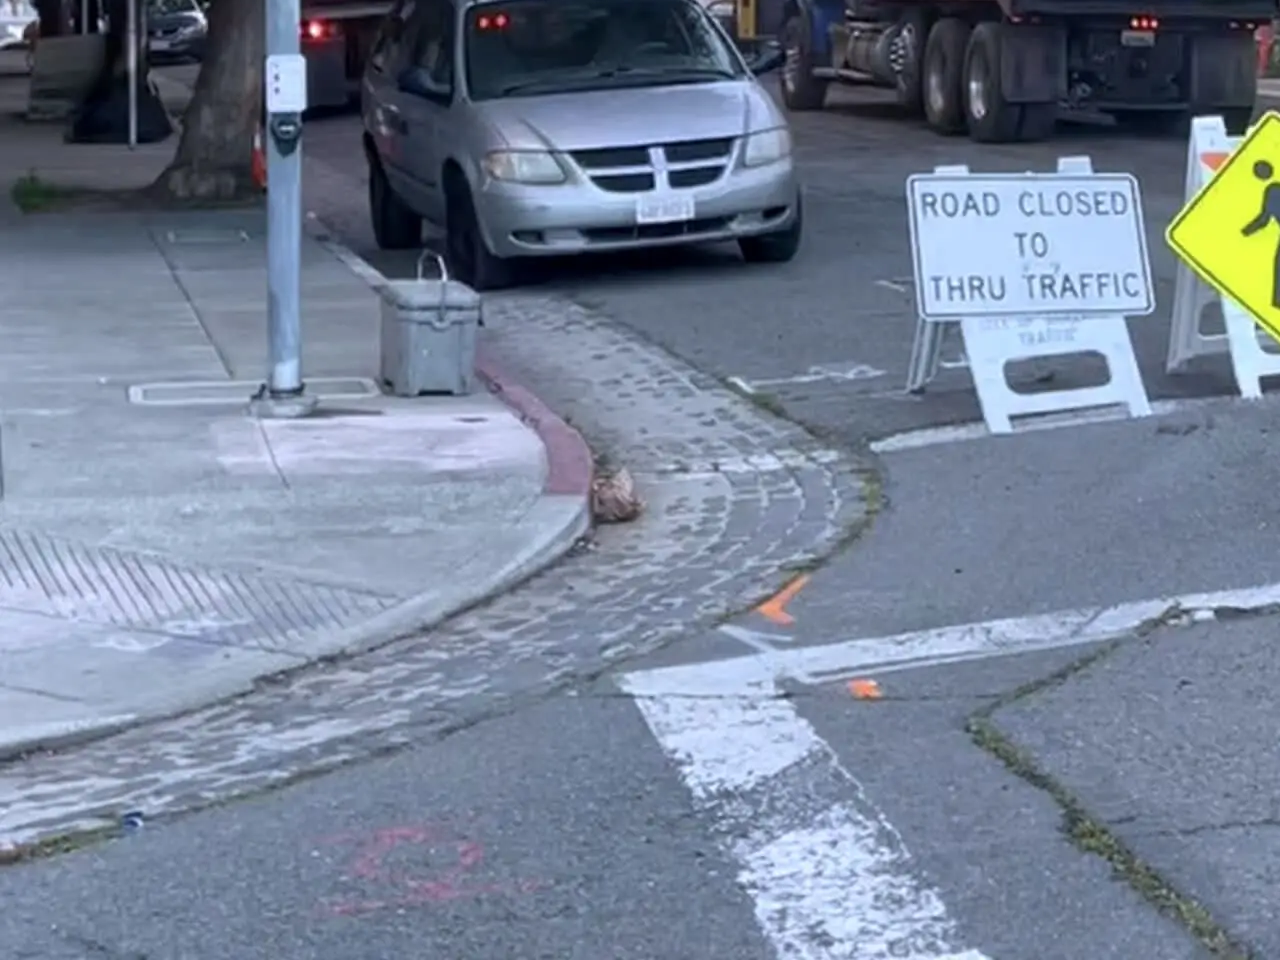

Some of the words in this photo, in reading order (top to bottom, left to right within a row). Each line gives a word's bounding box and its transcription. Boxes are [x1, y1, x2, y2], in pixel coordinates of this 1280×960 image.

[921, 192, 1000, 218] ROAD
[1018, 190, 1128, 218] CLOSED
[1013, 232, 1048, 258] TO
[930, 276, 1006, 302] THRU
[1022, 272, 1141, 300] TRAFFIC
